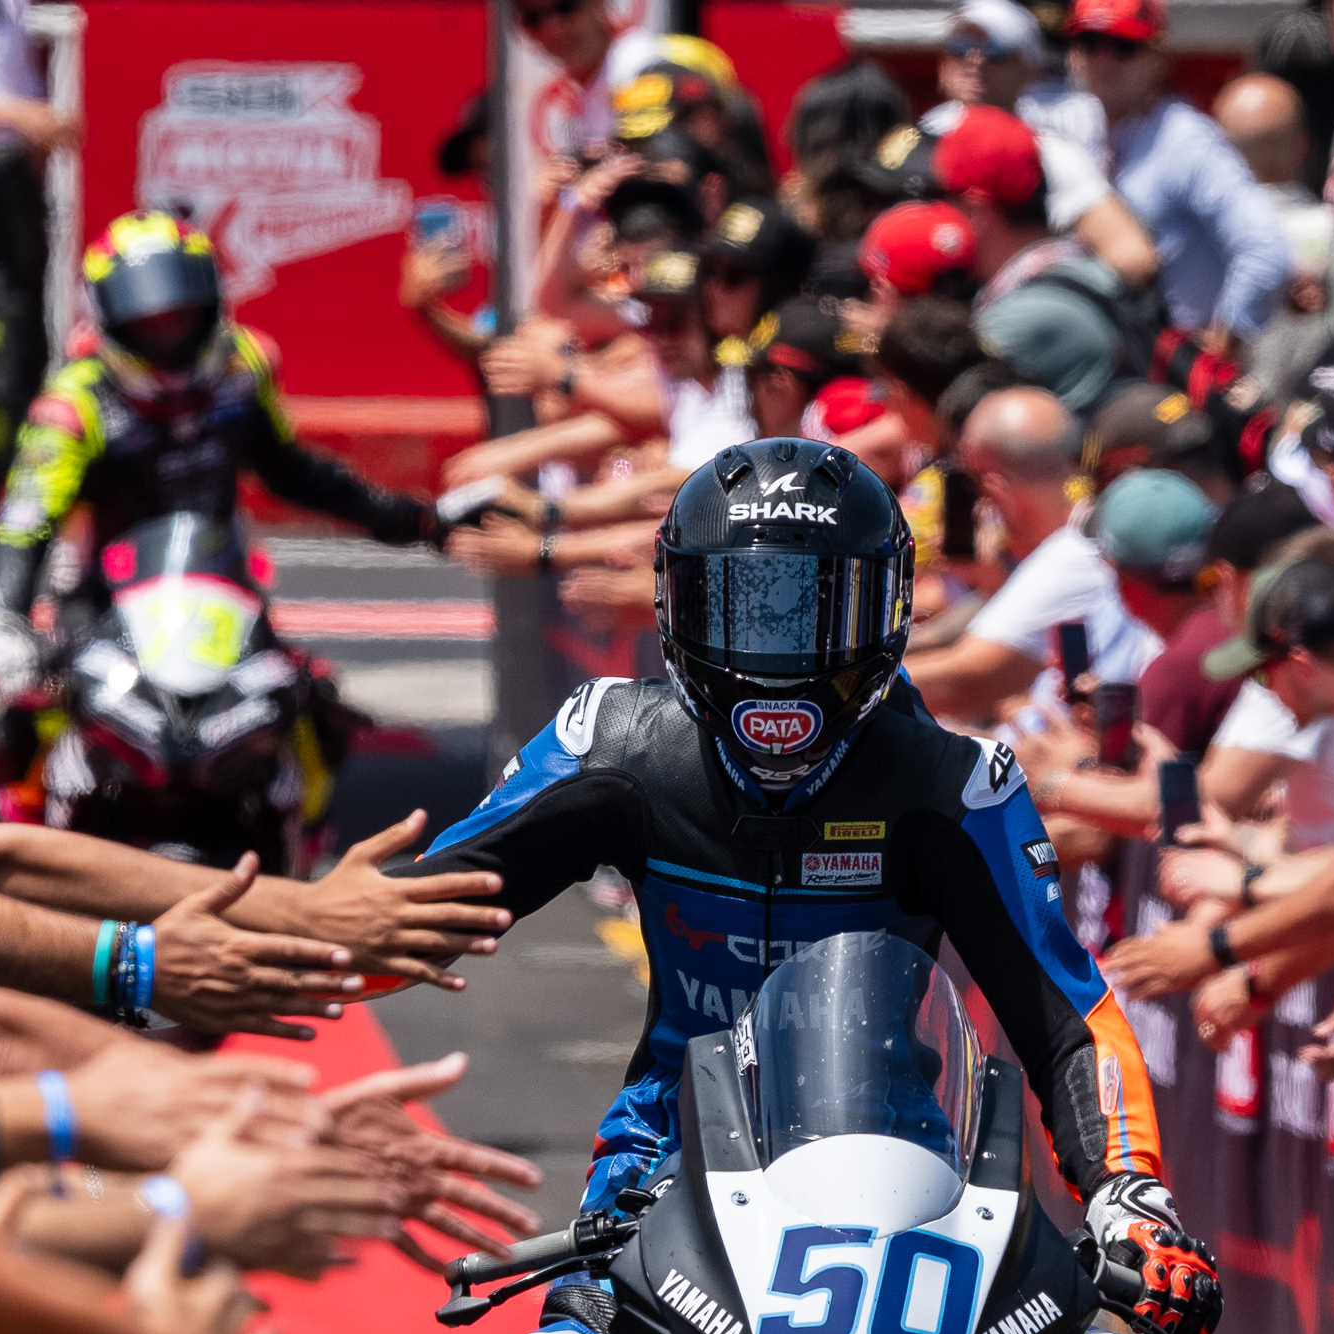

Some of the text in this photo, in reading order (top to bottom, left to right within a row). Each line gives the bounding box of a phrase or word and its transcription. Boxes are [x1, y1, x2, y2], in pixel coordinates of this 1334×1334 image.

[728, 501, 838, 525] SHARK
[757, 701, 797, 710] SNACK
[749, 717, 803, 738] PATA
[830, 825, 881, 837] PIRELLI
[822, 855, 880, 871] YAMAHA
[677, 969, 868, 1031] YAMAHA
